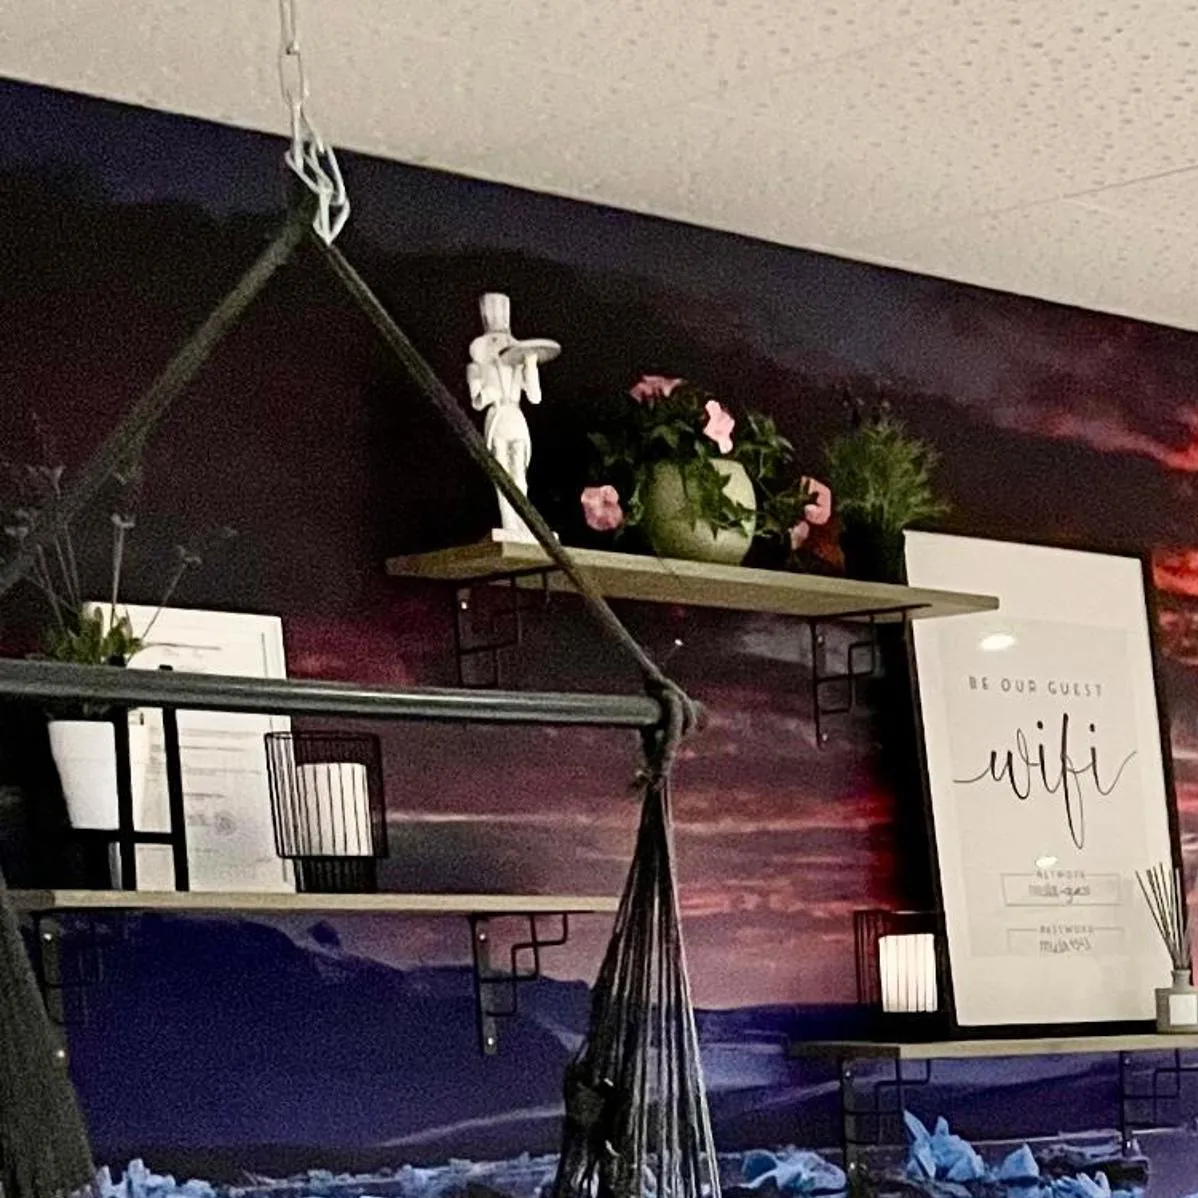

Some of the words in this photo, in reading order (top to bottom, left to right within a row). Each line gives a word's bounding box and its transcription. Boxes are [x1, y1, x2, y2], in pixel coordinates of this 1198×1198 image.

[969, 675, 990, 690] BE
[1000, 677, 1037, 693] OUR
[1048, 680, 1102, 697] GUEST
[953, 713, 1137, 850] wifi
